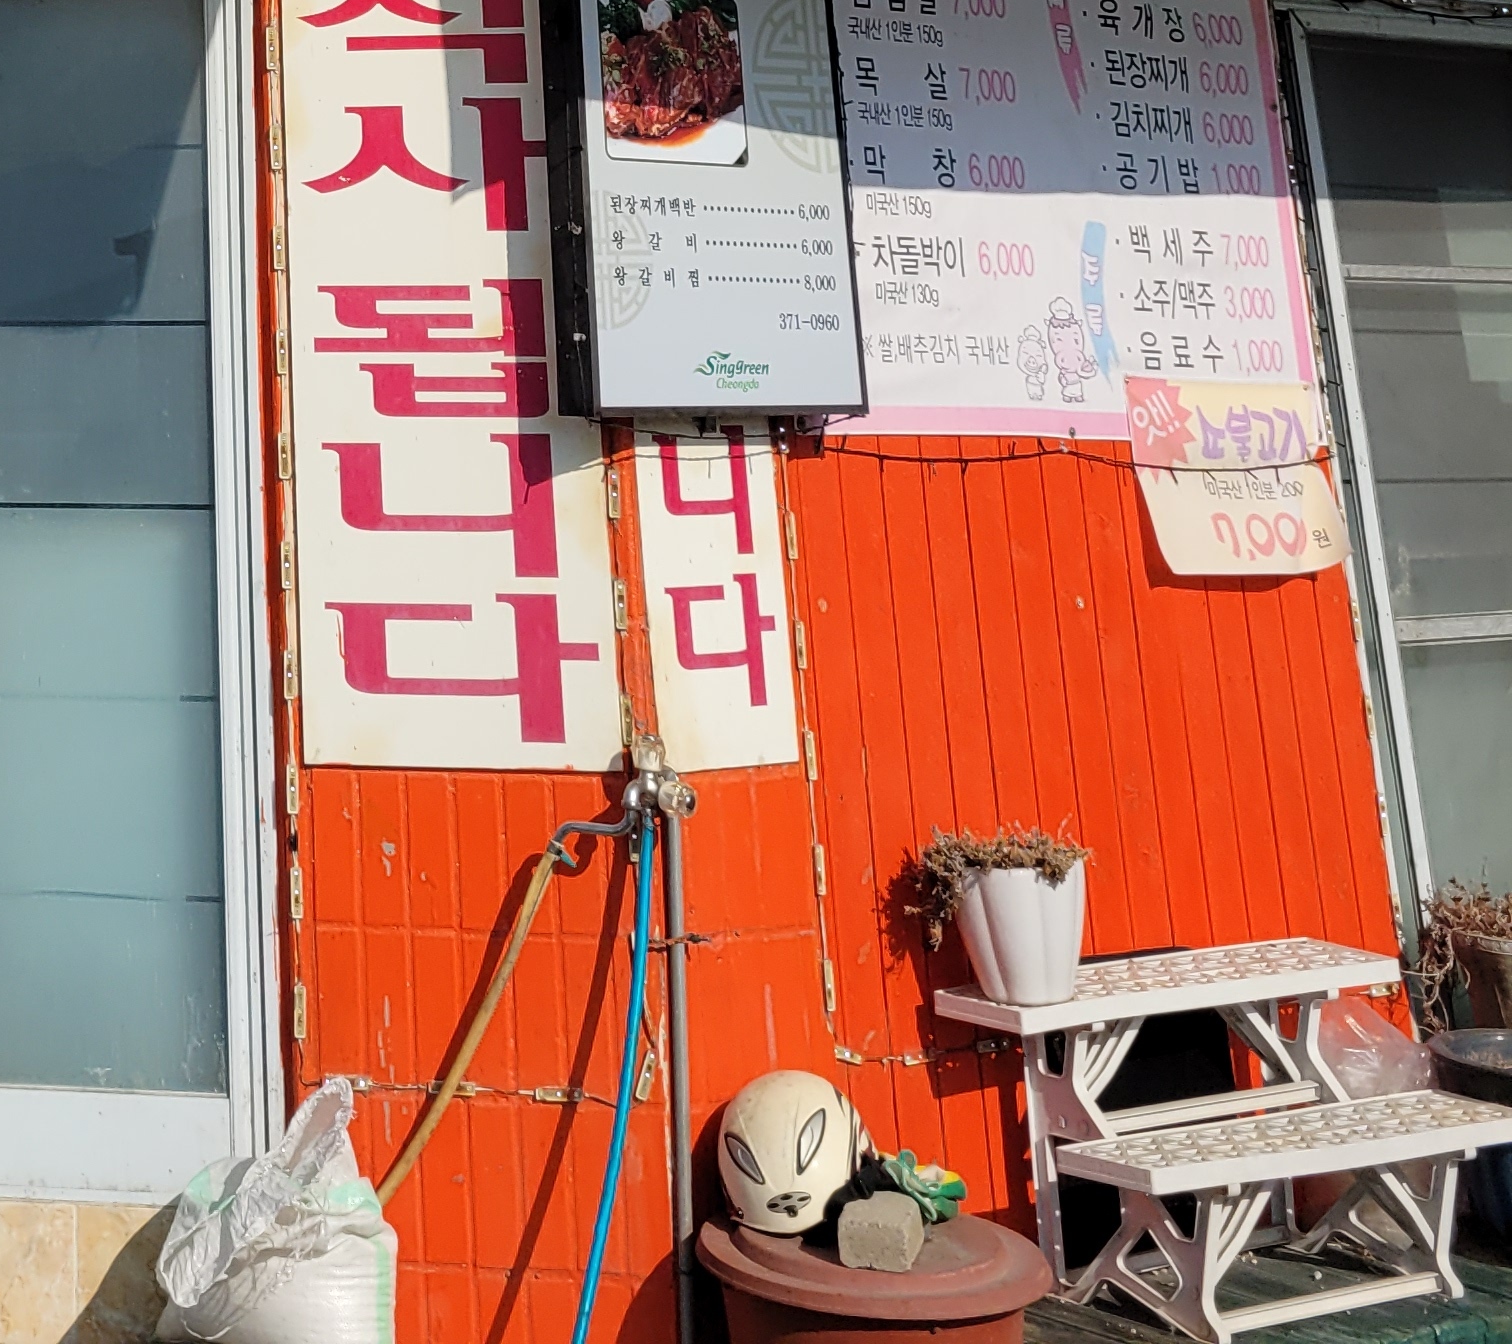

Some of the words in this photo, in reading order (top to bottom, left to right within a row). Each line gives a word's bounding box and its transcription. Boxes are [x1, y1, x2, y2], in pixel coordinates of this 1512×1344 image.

[847, 17, 881, 41] 국내산
[916, 23, 943, 47] 150g
[1192, 12, 1242, 48] 6,000
[958, 67, 1016, 105] 7,000
[1104, 49, 1189, 94] 된장찌개
[1199, 61, 1249, 98] 6,000
[857, 101, 891, 125] 국내산
[927, 108, 953, 131] 150g
[1110, 101, 1194, 145] 김치찌개
[1203, 111, 1254, 148] 6,000
[968, 153, 1025, 191] 6,000
[1212, 164, 1261, 196] 1,000
[610, 194, 696, 217] 된장찌개백반
[798, 204, 830, 222] 6,000
[866, 192, 899, 215] 미국산
[902, 195, 931, 218] 150g
[801, 239, 833, 257] 6,000
[872, 235, 966, 278] 차돌박이
[978, 241, 1034, 280] 6,000
[1220, 233, 1269, 270] 7,000
[803, 275, 836, 292] 8,000
[875, 281, 908, 305] 미국산
[911, 284, 939, 307] 130g
[1133, 278, 1216, 320] 소주/맥주
[1224, 285, 1275, 323] 3,000
[779, 313, 840, 331] 371-0960
[965, 336, 1010, 365] 국내산
[1232, 339, 1283, 376] 1,000
[1312, 527, 1333, 549] 원
